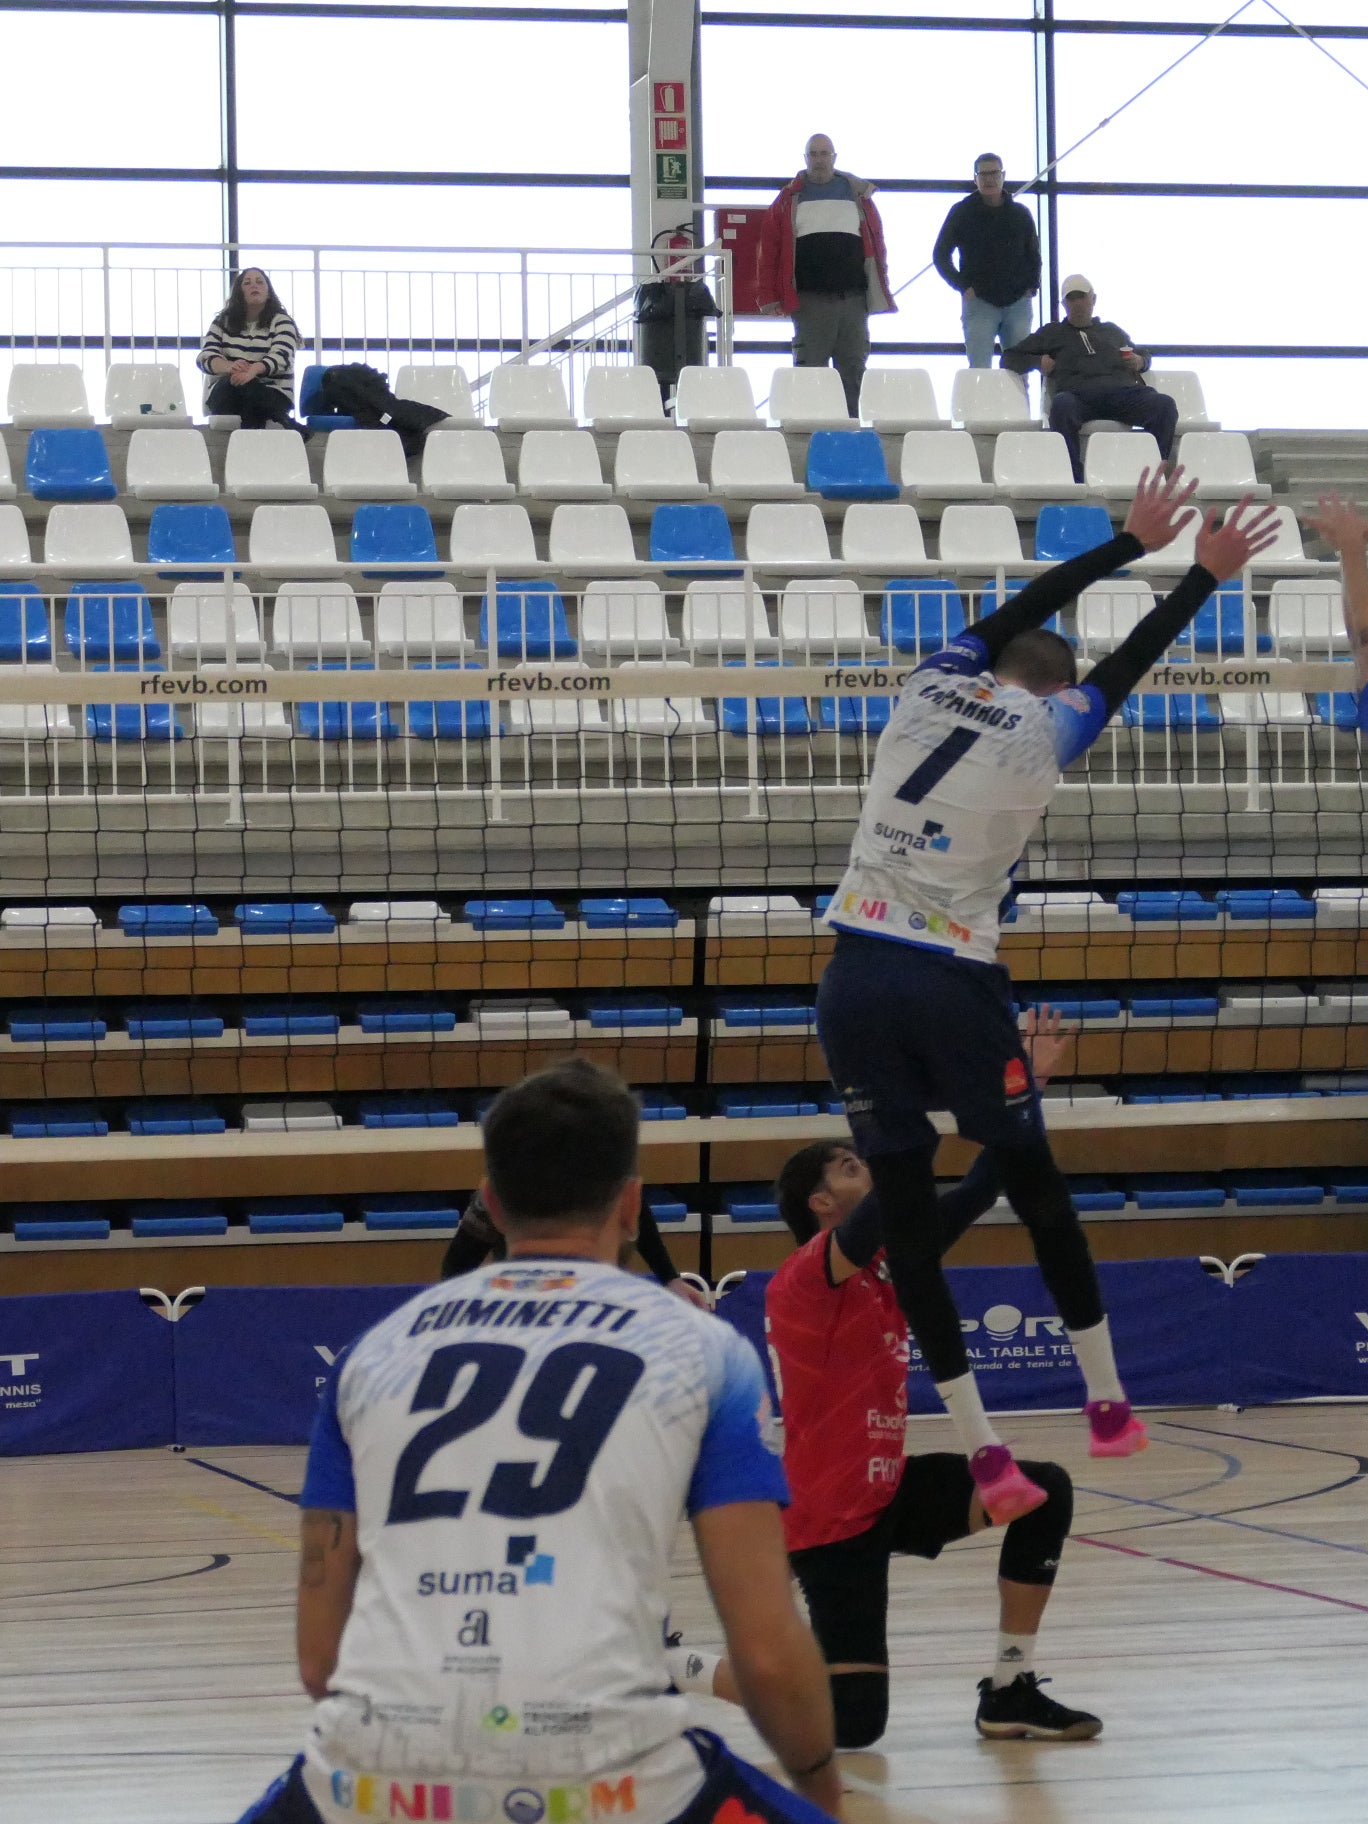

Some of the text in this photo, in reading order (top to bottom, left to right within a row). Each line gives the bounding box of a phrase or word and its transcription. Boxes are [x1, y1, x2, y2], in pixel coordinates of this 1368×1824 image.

[140, 674, 267, 695] rfevb.com
[487, 671, 611, 692] rfevb.com
[824, 668, 905, 688] rfevb.c
[1153, 666, 1270, 686] rfevb.com
[873, 821, 927, 851] suma
[990, 1347, 1046, 1358] TABLE
[1008, 1360, 1021, 1369] de
[1027, 1359, 1054, 1368] tenis
[1059, 1357, 1072, 1367] de
[0, 1384, 42, 1397] NNIS
[384, 1341, 646, 1527] 29
[417, 1568, 520, 1596] suma
